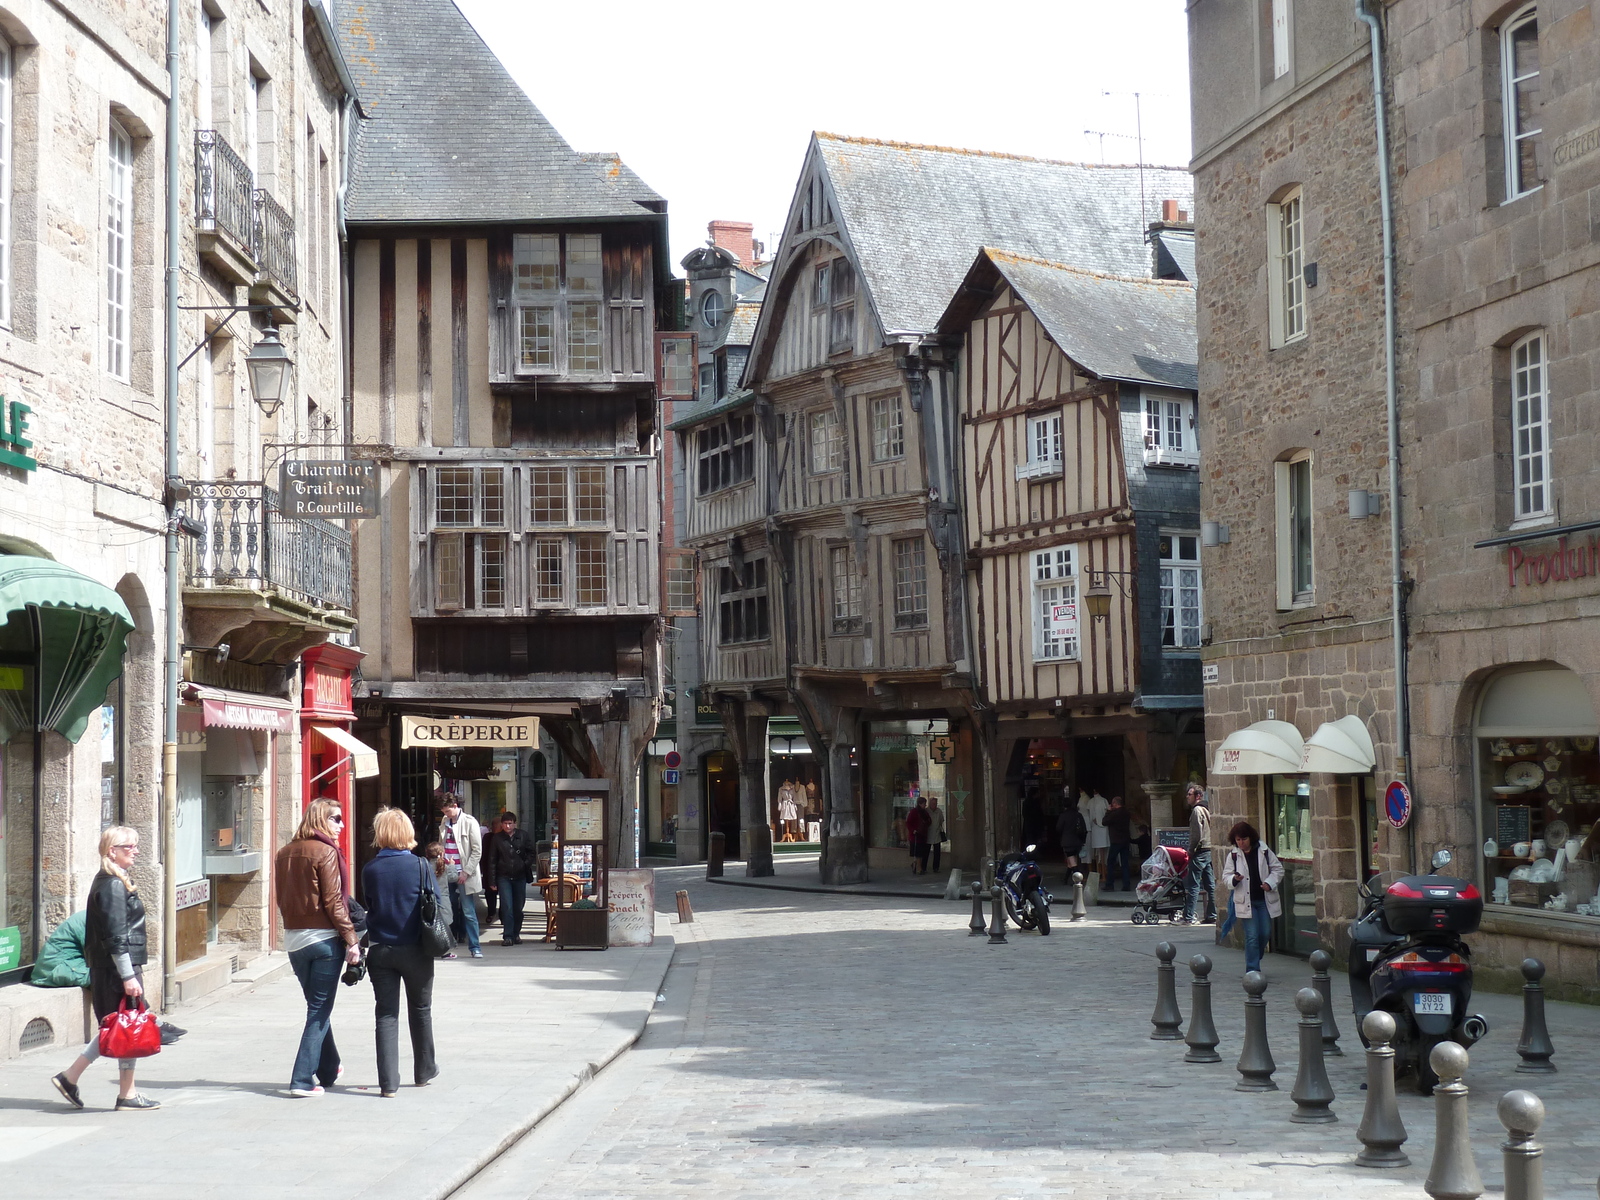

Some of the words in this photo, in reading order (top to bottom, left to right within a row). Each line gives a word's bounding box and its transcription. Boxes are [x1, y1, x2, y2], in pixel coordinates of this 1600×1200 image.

[291, 479, 365, 495] Traiteur
[1507, 534, 1600, 587] Produi
[225, 704, 248, 723] ARTISAN
[249, 707, 280, 727] CHARCUTIER
[697, 705, 718, 713] ROL
[413, 722, 529, 741] CRÊPERIE
[608, 902, 639, 913] Snack
[1421, 994, 1443, 1003] 3030
[1421, 1003, 1432, 1011] XY
[1433, 1003, 1444, 1011] 22
